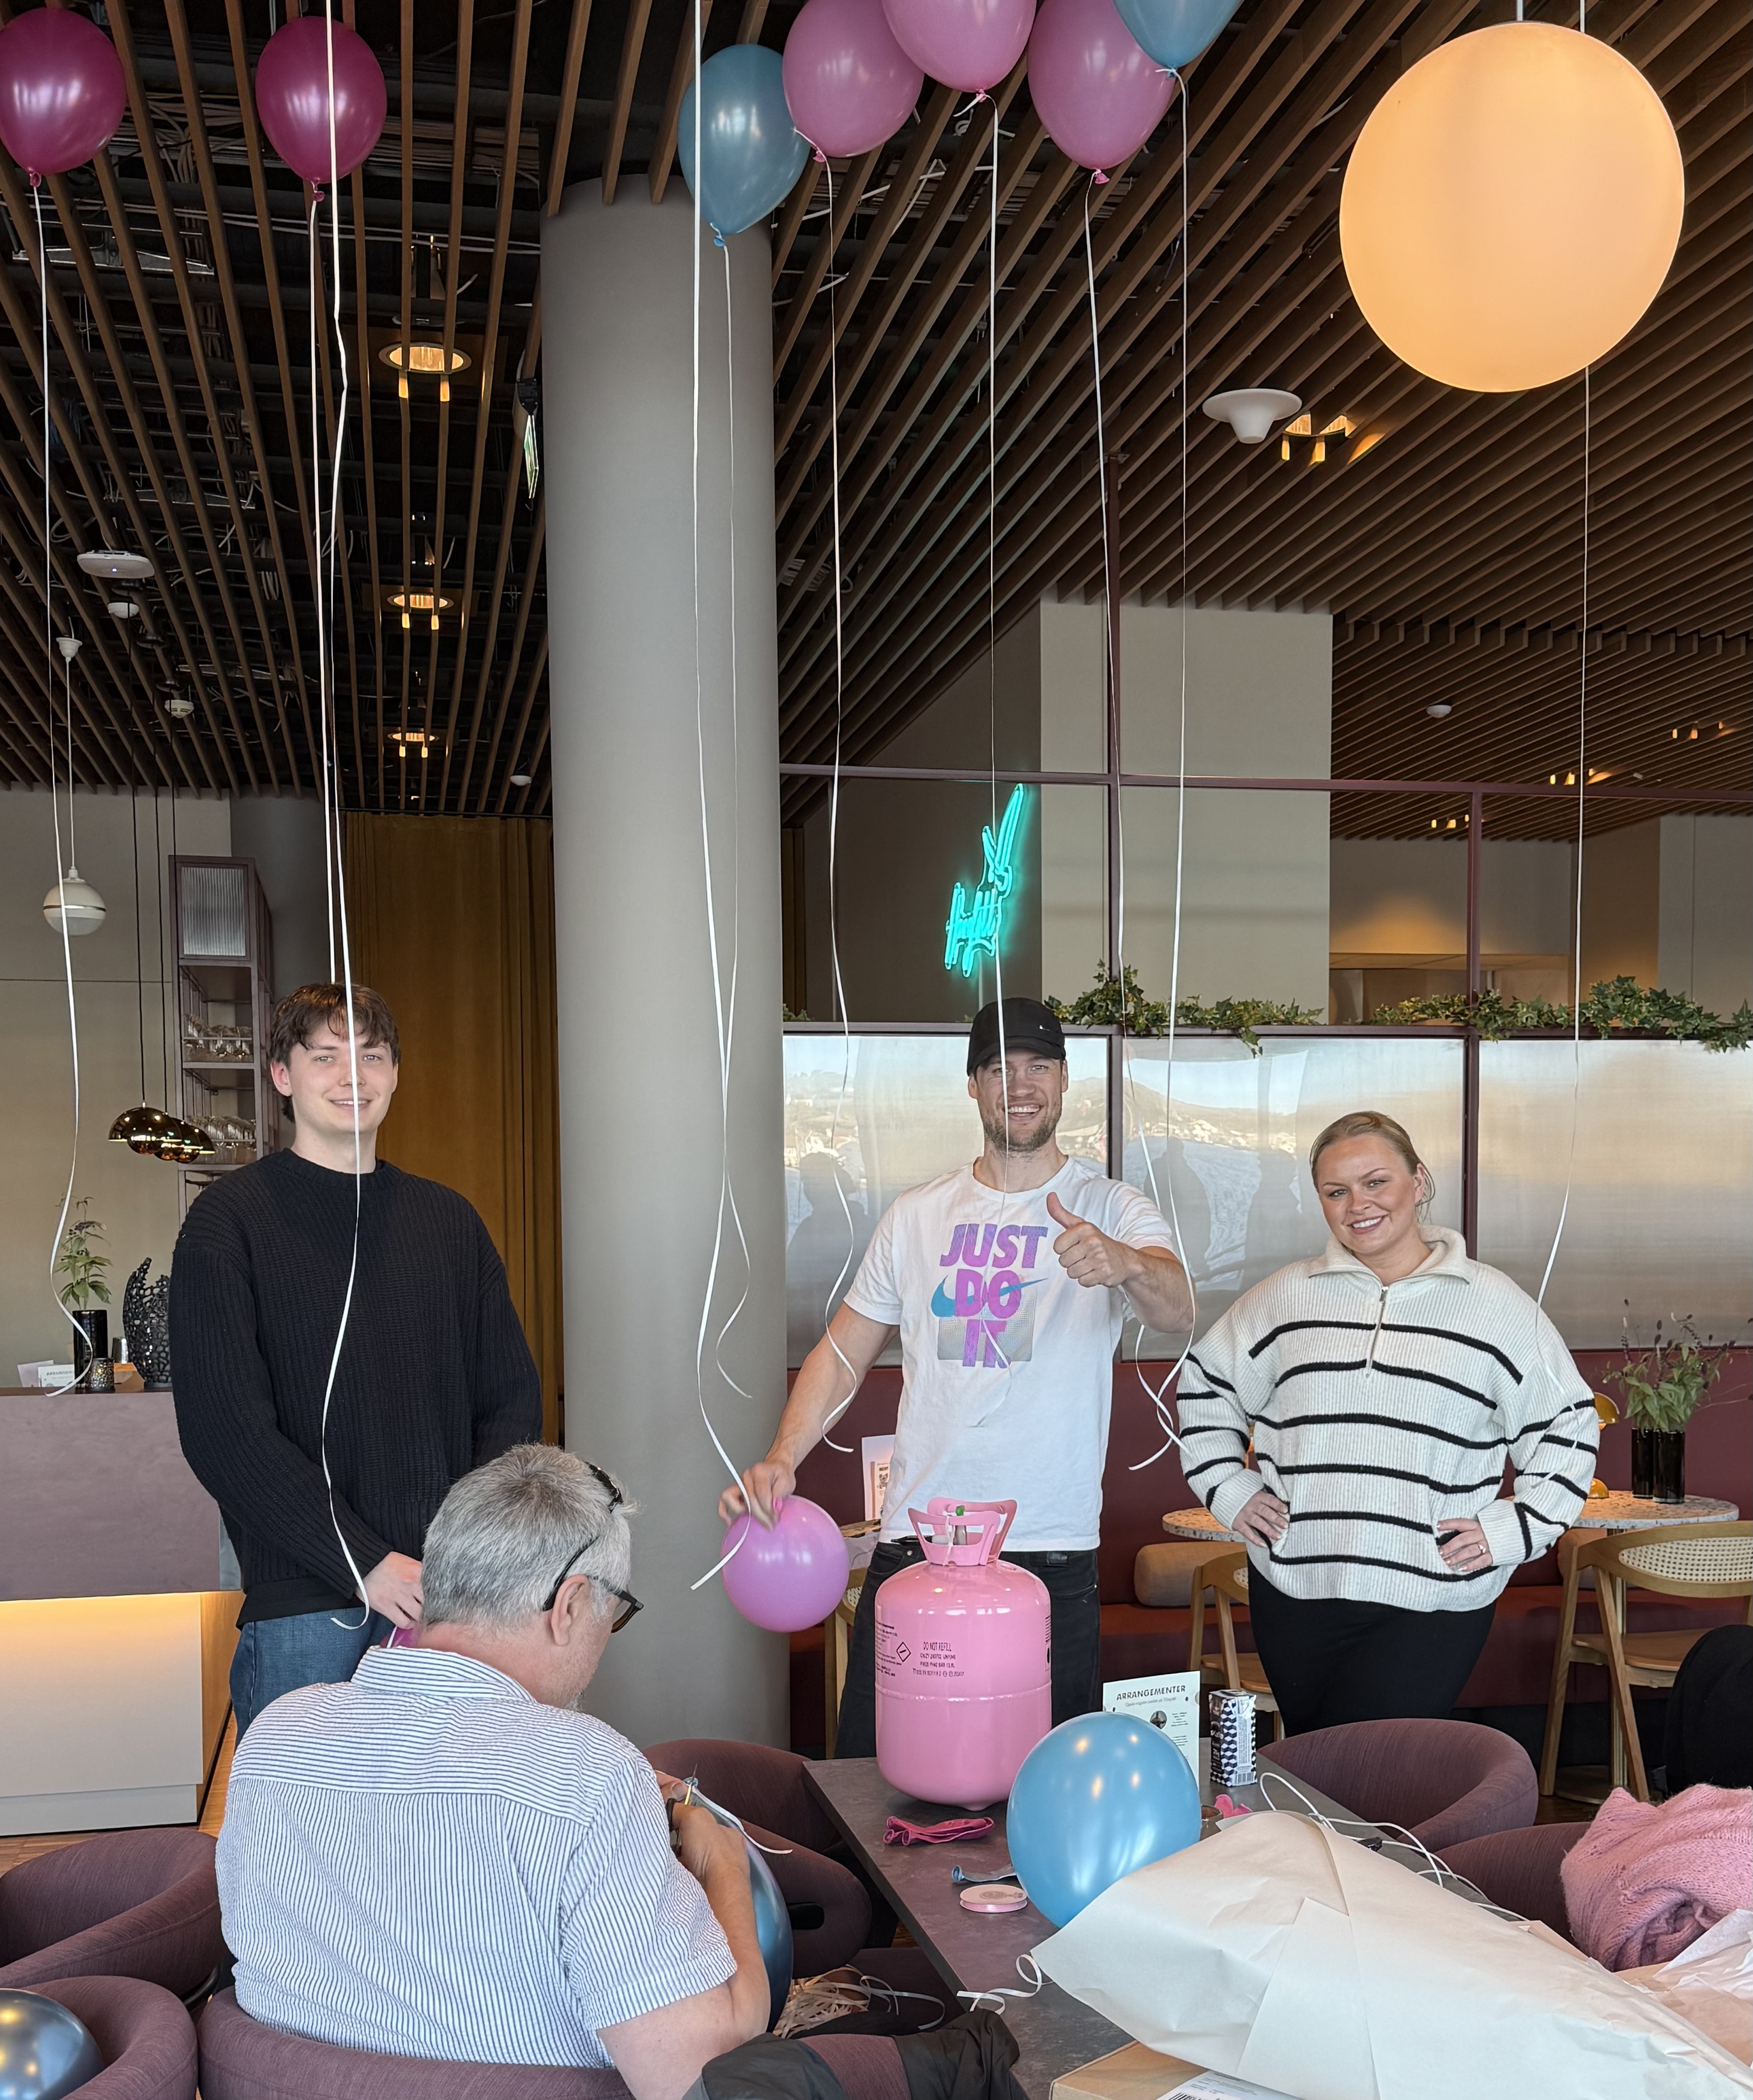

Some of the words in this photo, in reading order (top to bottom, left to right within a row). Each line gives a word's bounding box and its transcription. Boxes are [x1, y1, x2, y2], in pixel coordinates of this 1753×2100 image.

[939, 1223, 1048, 1268] JUST
[955, 1268, 1021, 1319] DO
[1116, 1685, 1186, 1701] ARRANGEMENTER
